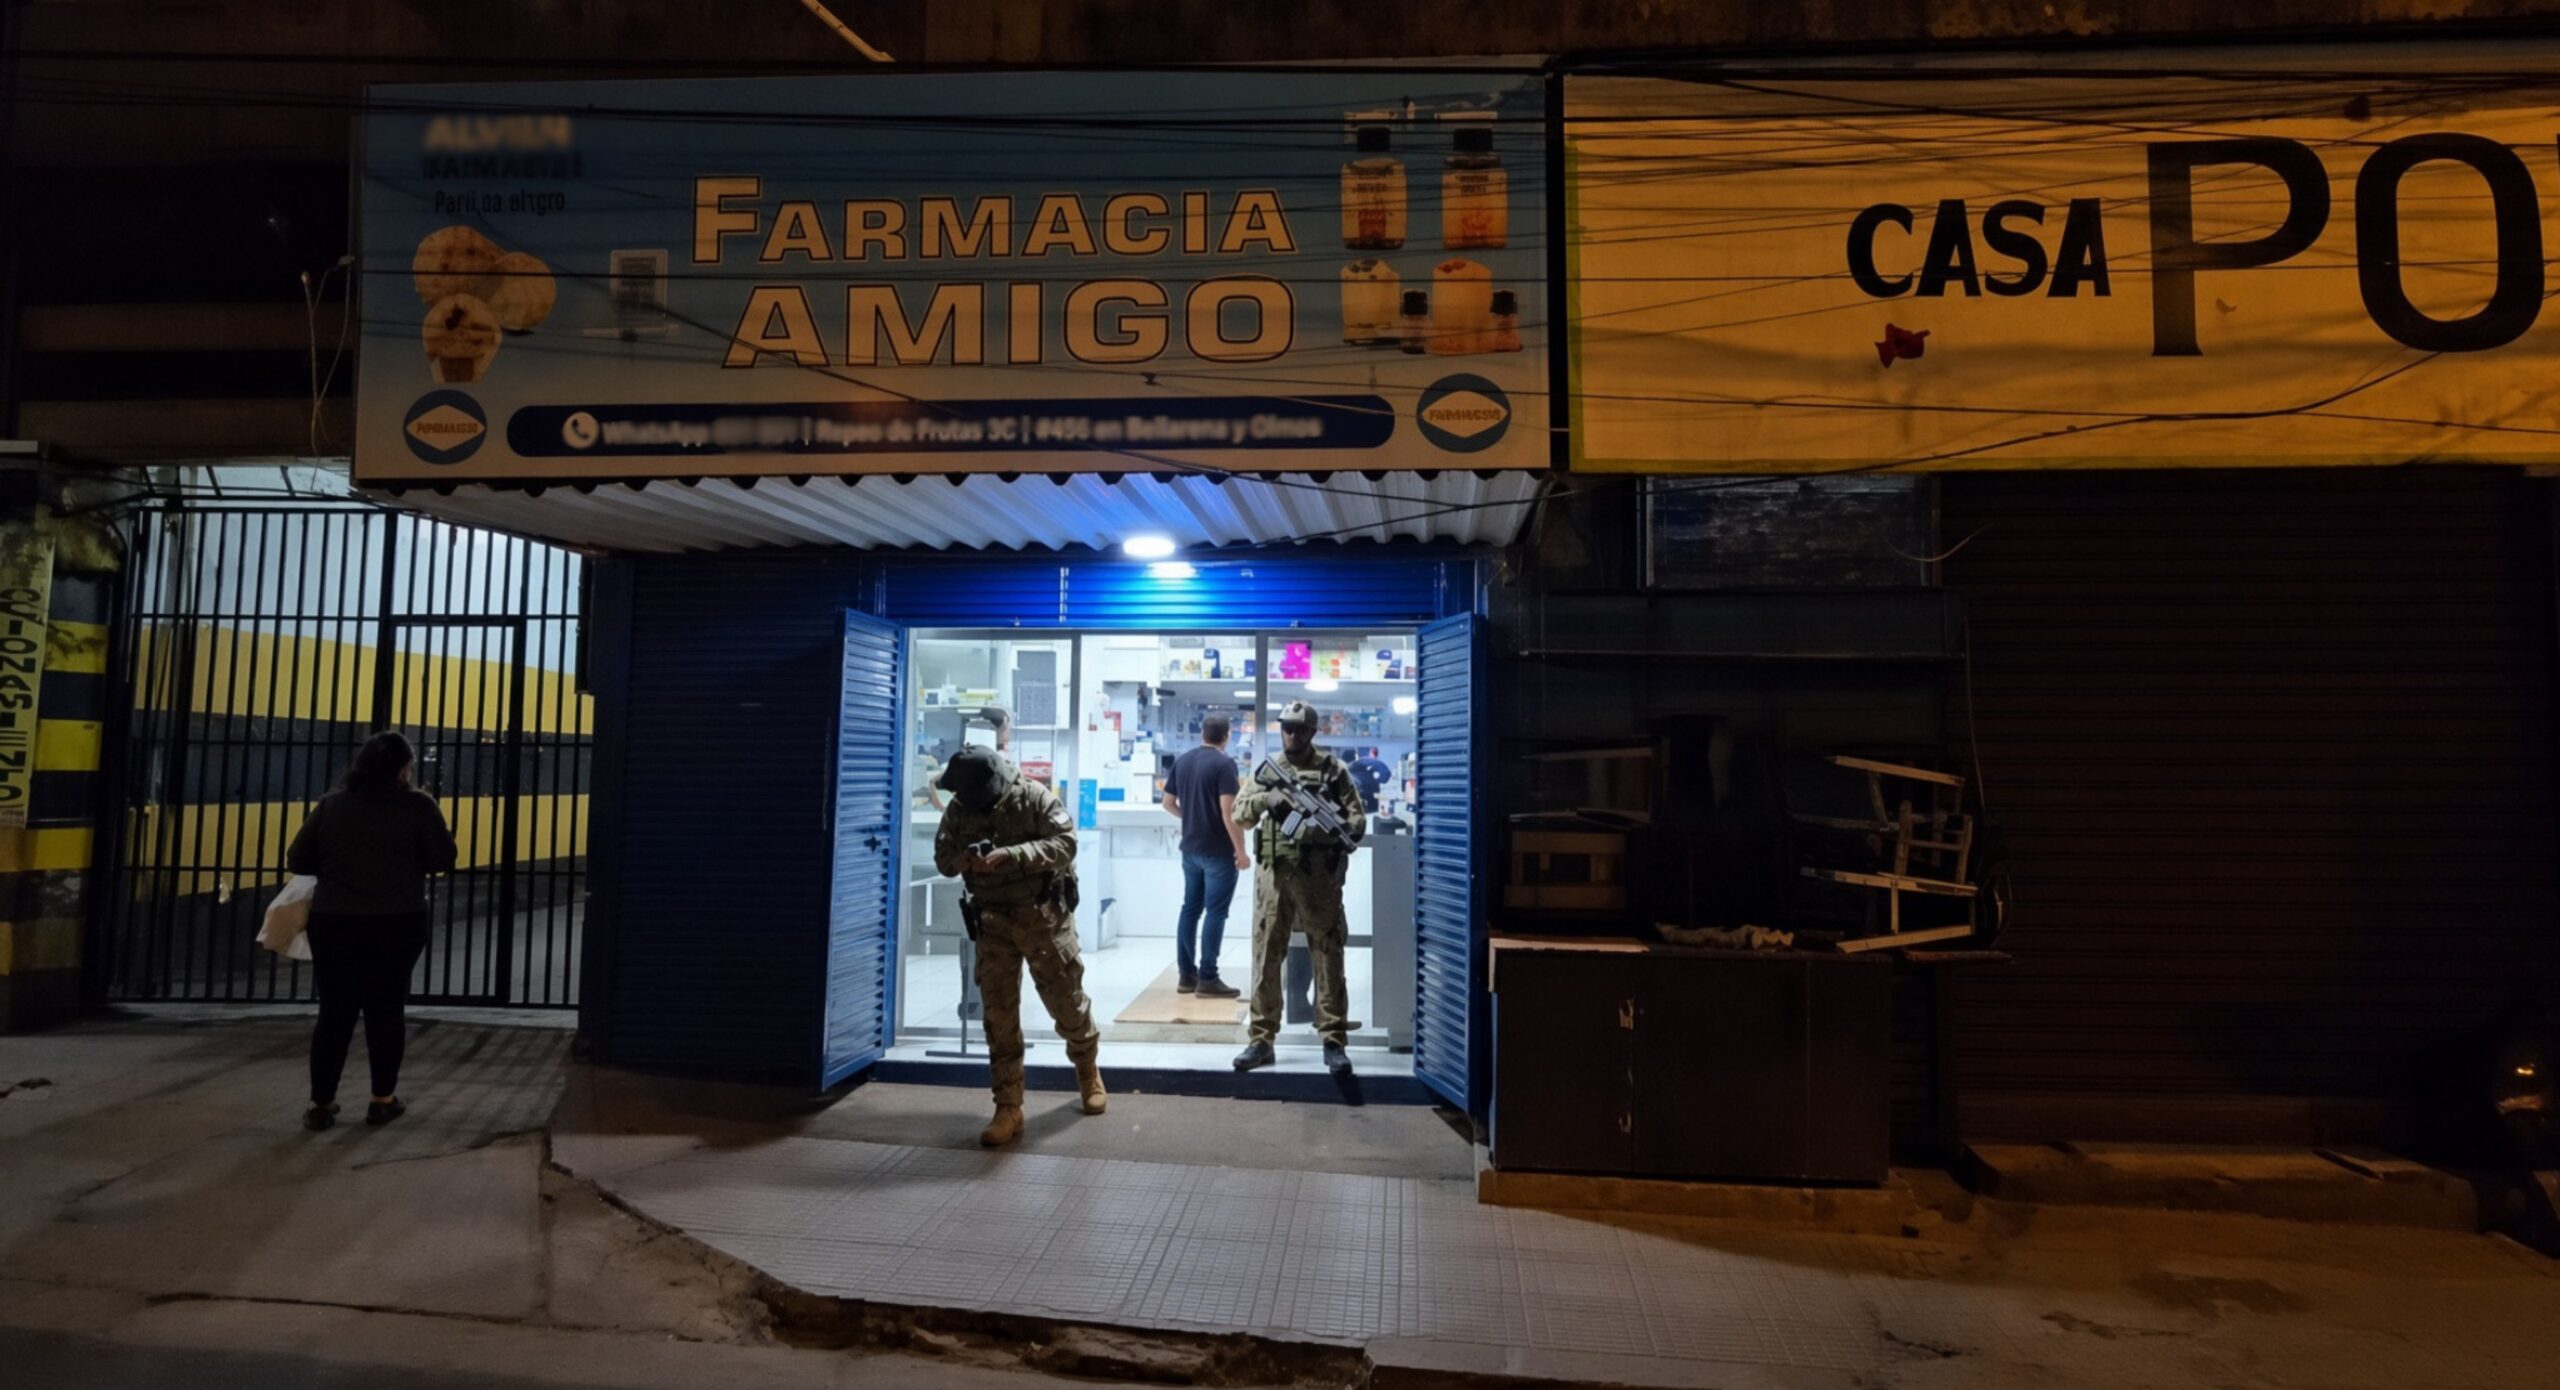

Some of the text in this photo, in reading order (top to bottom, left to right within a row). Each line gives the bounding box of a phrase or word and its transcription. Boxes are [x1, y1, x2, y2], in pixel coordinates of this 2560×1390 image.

[721, 275, 1296, 369] AMIGO
[1846, 132, 2560, 357] CASA PO
